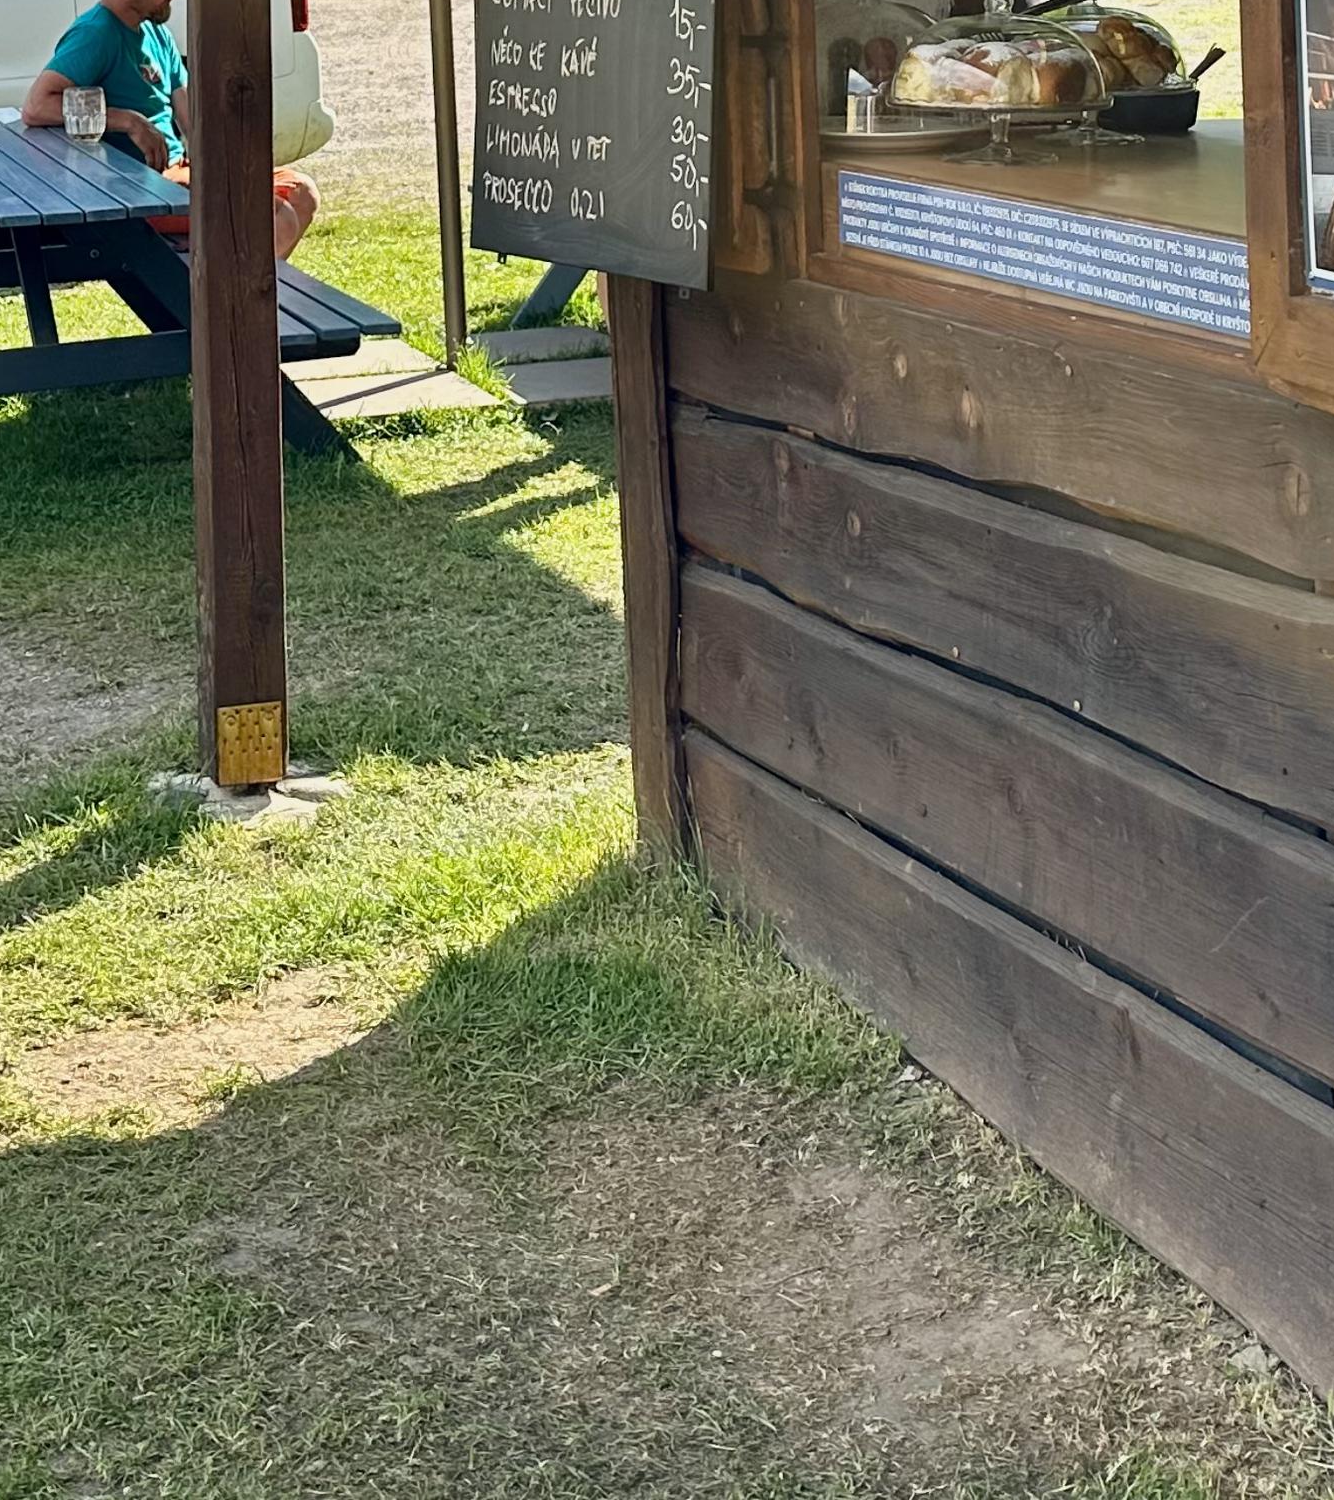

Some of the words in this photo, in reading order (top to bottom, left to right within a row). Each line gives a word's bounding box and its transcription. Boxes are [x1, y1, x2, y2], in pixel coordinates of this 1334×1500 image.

[529, 41, 547, 71] KE
[667, 57, 712, 109] 35,-
[489, 79, 558, 118] ESPRESSO
[671, 115, 709, 156] 30,-
[487, 124, 559, 168] LIMONÁDA
[586, 136, 611, 161] PET
[670, 154, 709, 197] 50,-
[483, 171, 553, 213] PROSECCO
[671, 200, 707, 250] 60,-
